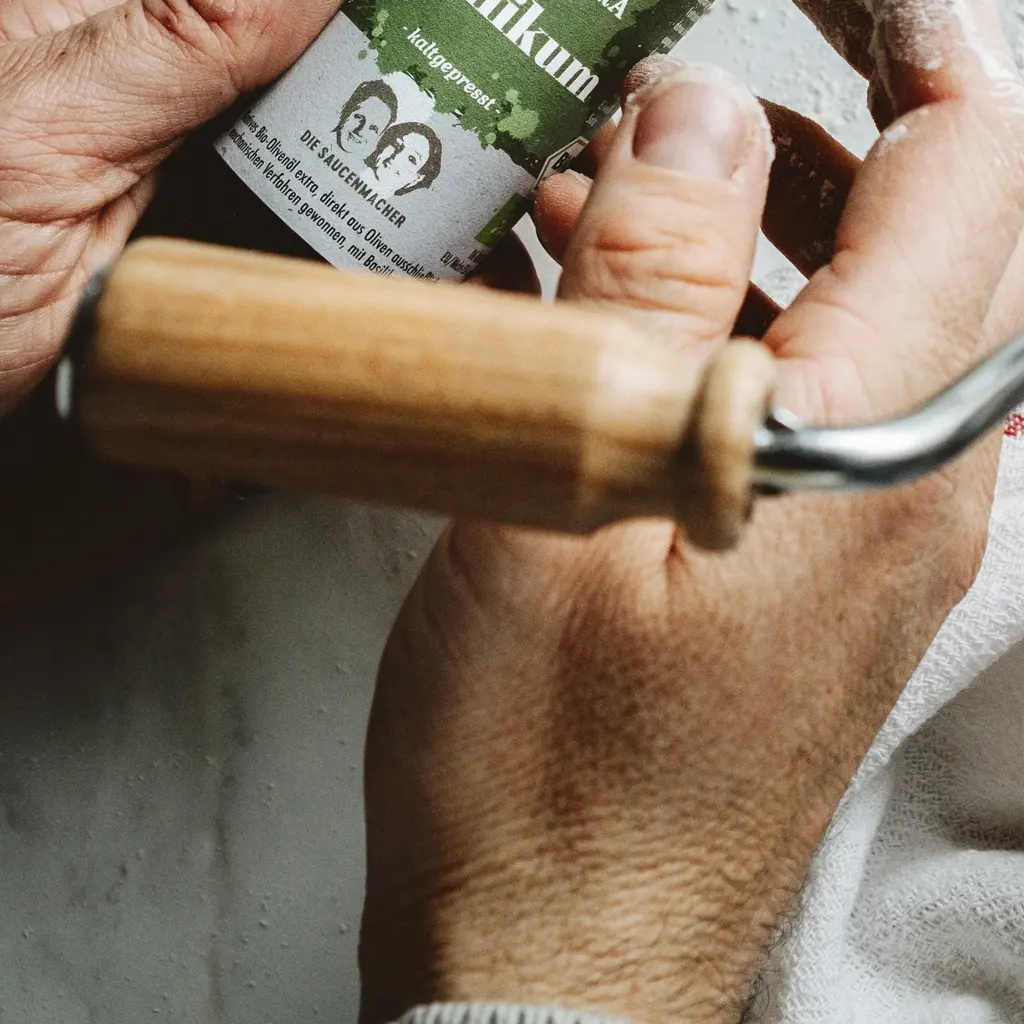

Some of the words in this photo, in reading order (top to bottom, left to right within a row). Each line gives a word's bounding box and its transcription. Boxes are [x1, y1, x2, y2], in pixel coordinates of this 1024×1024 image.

[406, 27, 497, 112] kaltgepresst
[255, 125, 301, 173] Bio-Olivenöl
[294, 169, 319, 197] extra,
[319, 191, 350, 220] direkt
[346, 217, 366, 235] aus
[364, 228, 393, 258] Oliven
[262, 162, 302, 205] Verfahren
[297, 202, 346, 250] gewonnen,
[347, 244, 367, 261] mit
[299, 129, 321, 152] DIE
[317, 146, 407, 229] SAUCENMACHER
